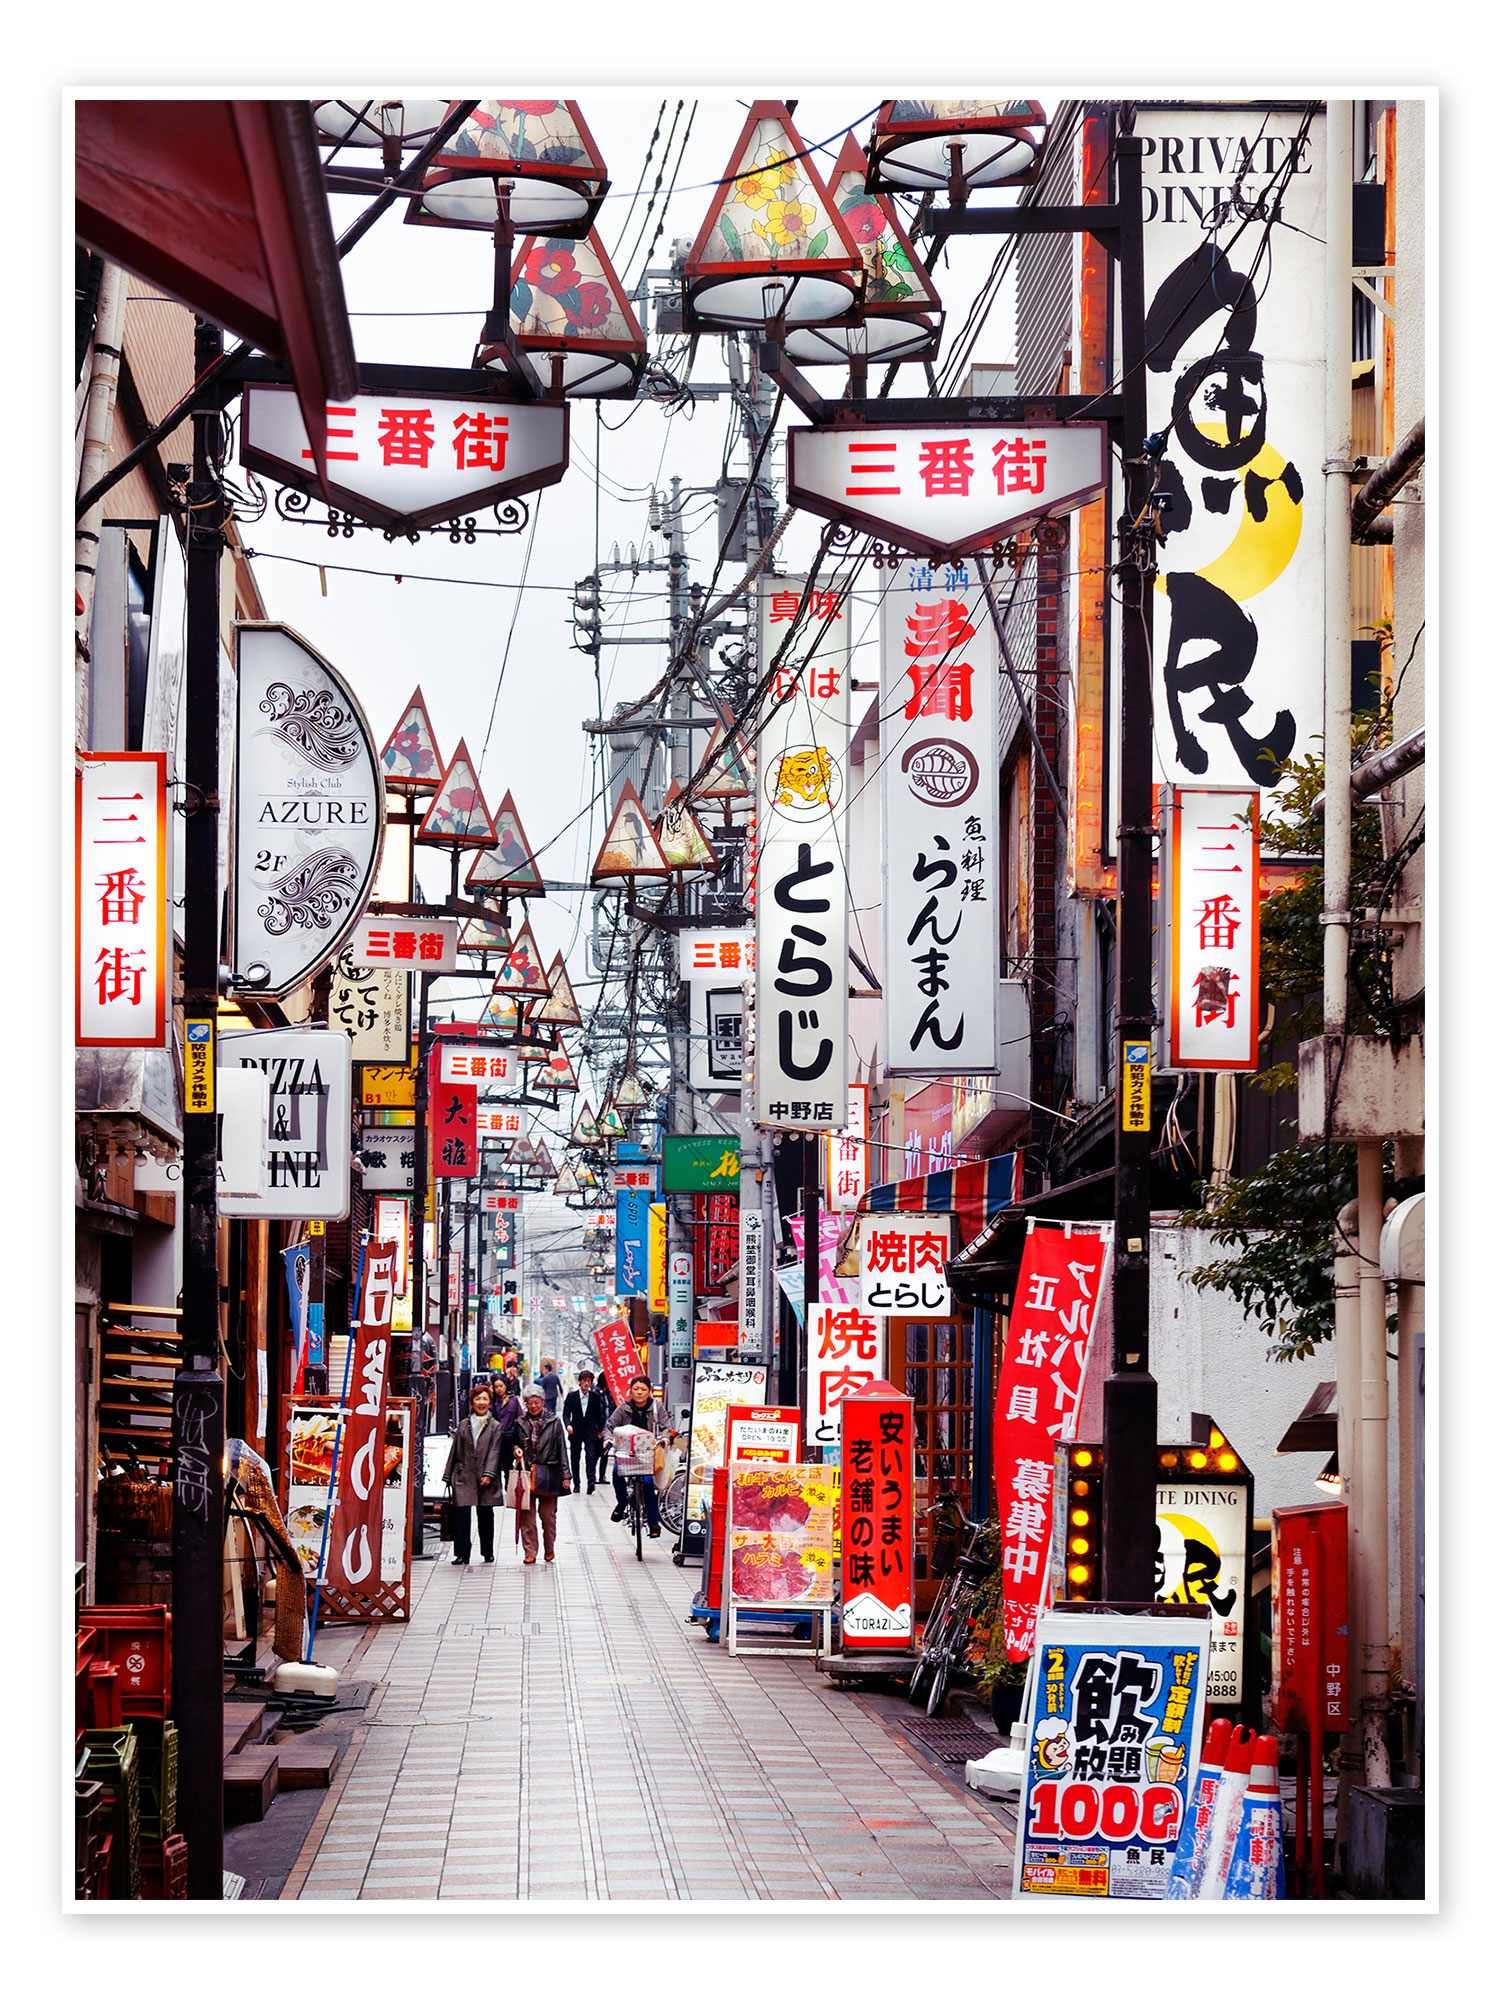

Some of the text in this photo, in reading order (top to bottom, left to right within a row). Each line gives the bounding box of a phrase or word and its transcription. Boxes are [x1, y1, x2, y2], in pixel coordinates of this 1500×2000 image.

[1140, 136, 1313, 175] PRIVATE
[301, 406, 510, 472] 三番街
[844, 437, 1048, 499] 三番街
[1145, 243, 1304, 788] 魚民
[907, 566, 971, 593] 清酒
[902, 597, 977, 723] 多聞
[286, 777, 343, 790] Stylish Club
[257, 800, 370, 825] AZURE
[253, 849, 288, 873] 2F
[960, 814, 988, 902] 魚料理
[92, 791, 147, 1007] 三番街
[365, 930, 445, 961] 三番街
[906, 834, 967, 1053] らんまん
[773, 842, 835, 1082] とらじ
[190, 1042, 208, 1108] 防犯カメラ作動中
[238, 1057, 328, 1096] ZZA
[450, 1056, 508, 1078] 三番街
[365, 1093, 382, 1104] B1
[768, 1101, 834, 1122] 中野店
[1128, 1063, 1146, 1129] 防犯カメラ作動中
[272, 1103, 291, 1142] &
[476, 1113, 520, 1131] 三番街
[267, 1150, 322, 1189] INE
[613, 1172, 650, 1187] 三番街
[486, 1196, 519, 1209] 三番街
[627, 1201, 639, 1227] SPOT
[866, 1230, 949, 1275] 焼肉
[866, 1282, 946, 1309] とらじ
[816, 1306, 878, 1417] 焼肉
[814, 1420, 841, 1442] と
[760, 1482, 801, 1499] カルビ
[879, 1410, 905, 1576] 安いうまい
[1183, 1490, 1239, 1506] DINING
[849, 1437, 875, 1588] 老舗の味
[741, 1551, 782, 1567] ハラミ
[1285, 1567, 1296, 1666] 手を触れないで下さい
[1301, 1568, 1311, 1646] 非常の場合以外は
[854, 1617, 892, 1631] TORAZI
[1205, 1684, 1238, 1697] 9888
[1325, 1663, 1342, 1716] 中野区
[1025, 1867, 1055, 1877] モバイル
[1126, 1848, 1165, 1866] 魚民
[1078, 1869, 1108, 1887] 無料
